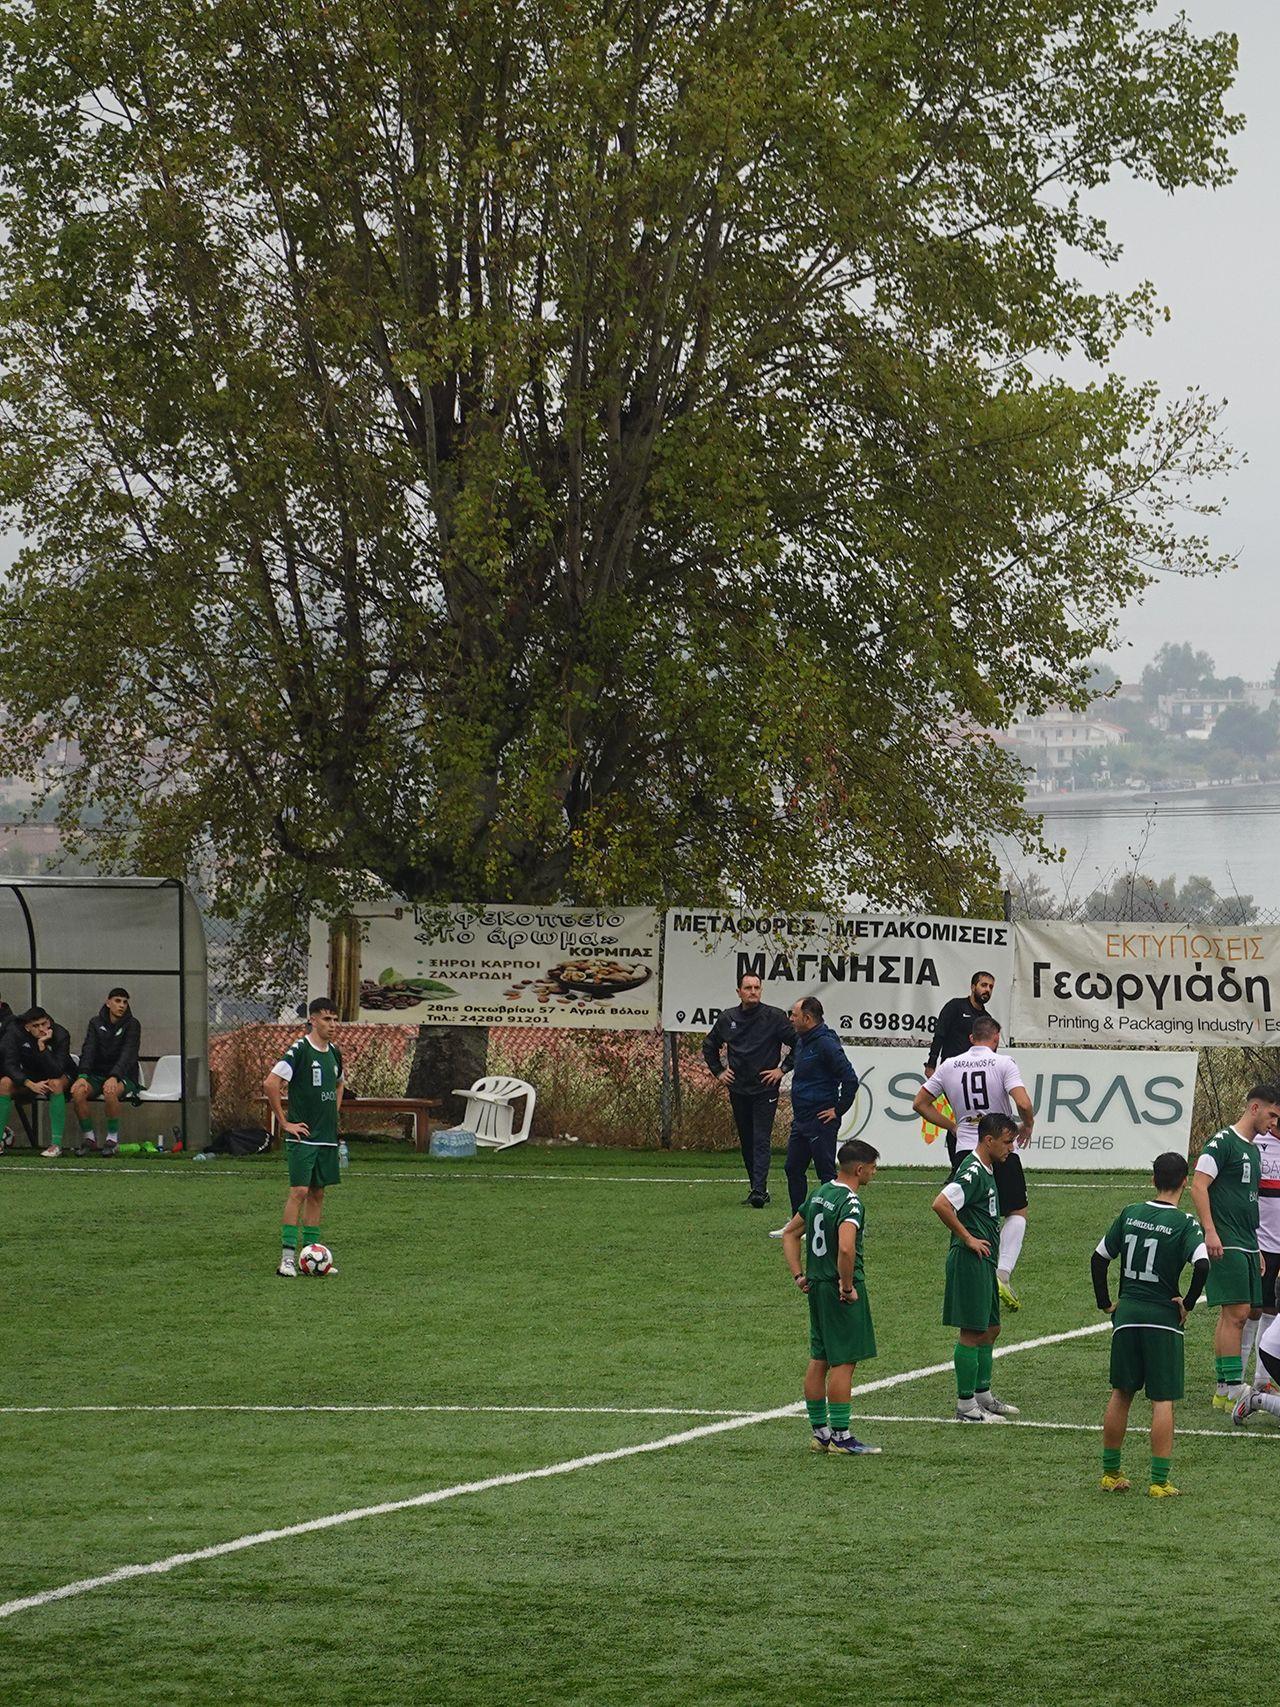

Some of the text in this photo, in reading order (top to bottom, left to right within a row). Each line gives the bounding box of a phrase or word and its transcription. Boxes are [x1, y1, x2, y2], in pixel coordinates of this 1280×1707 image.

[673, 914, 815, 936] ΜΕΤΑΦΟΡΕΣ
[835, 920, 1008, 946] ΜΕΤΑΚΟΜΙΣΕΙΣ
[569, 947, 653, 957] ΚΟΡΜΠΑΣ
[1105, 933, 1265, 961] ΕΚΤΥΠΩΣΕΙΣ
[428, 959, 540, 969] ΞΗΡΟΙ ΚΑΡΠΟΙ
[428, 970, 512, 980] ΖΑΧΑΡΩΔΗ
[736, 952, 940, 987] ΜΑΓΝΗΣΙΑ
[1032, 961, 1272, 1012] Γεωργιάδη
[460, 1015, 503, 1023] 24280
[507, 1015, 550, 1023] 91201
[463, 1004, 535, 1014] Οκτωβρίου
[569, 1006, 606, 1016] Αγριά
[610, 1007, 649, 1015] Βόλου
[1047, 1014, 1099, 1032] Printing
[1119, 1016, 1193, 1034] Packaging
[1197, 1017, 1253, 1034] Industry
[961, 1070, 990, 1111] 19
[1071, 1136, 1114, 1150] 1926
[812, 1213, 828, 1257] 8
[1123, 1233, 1159, 1283] 11
